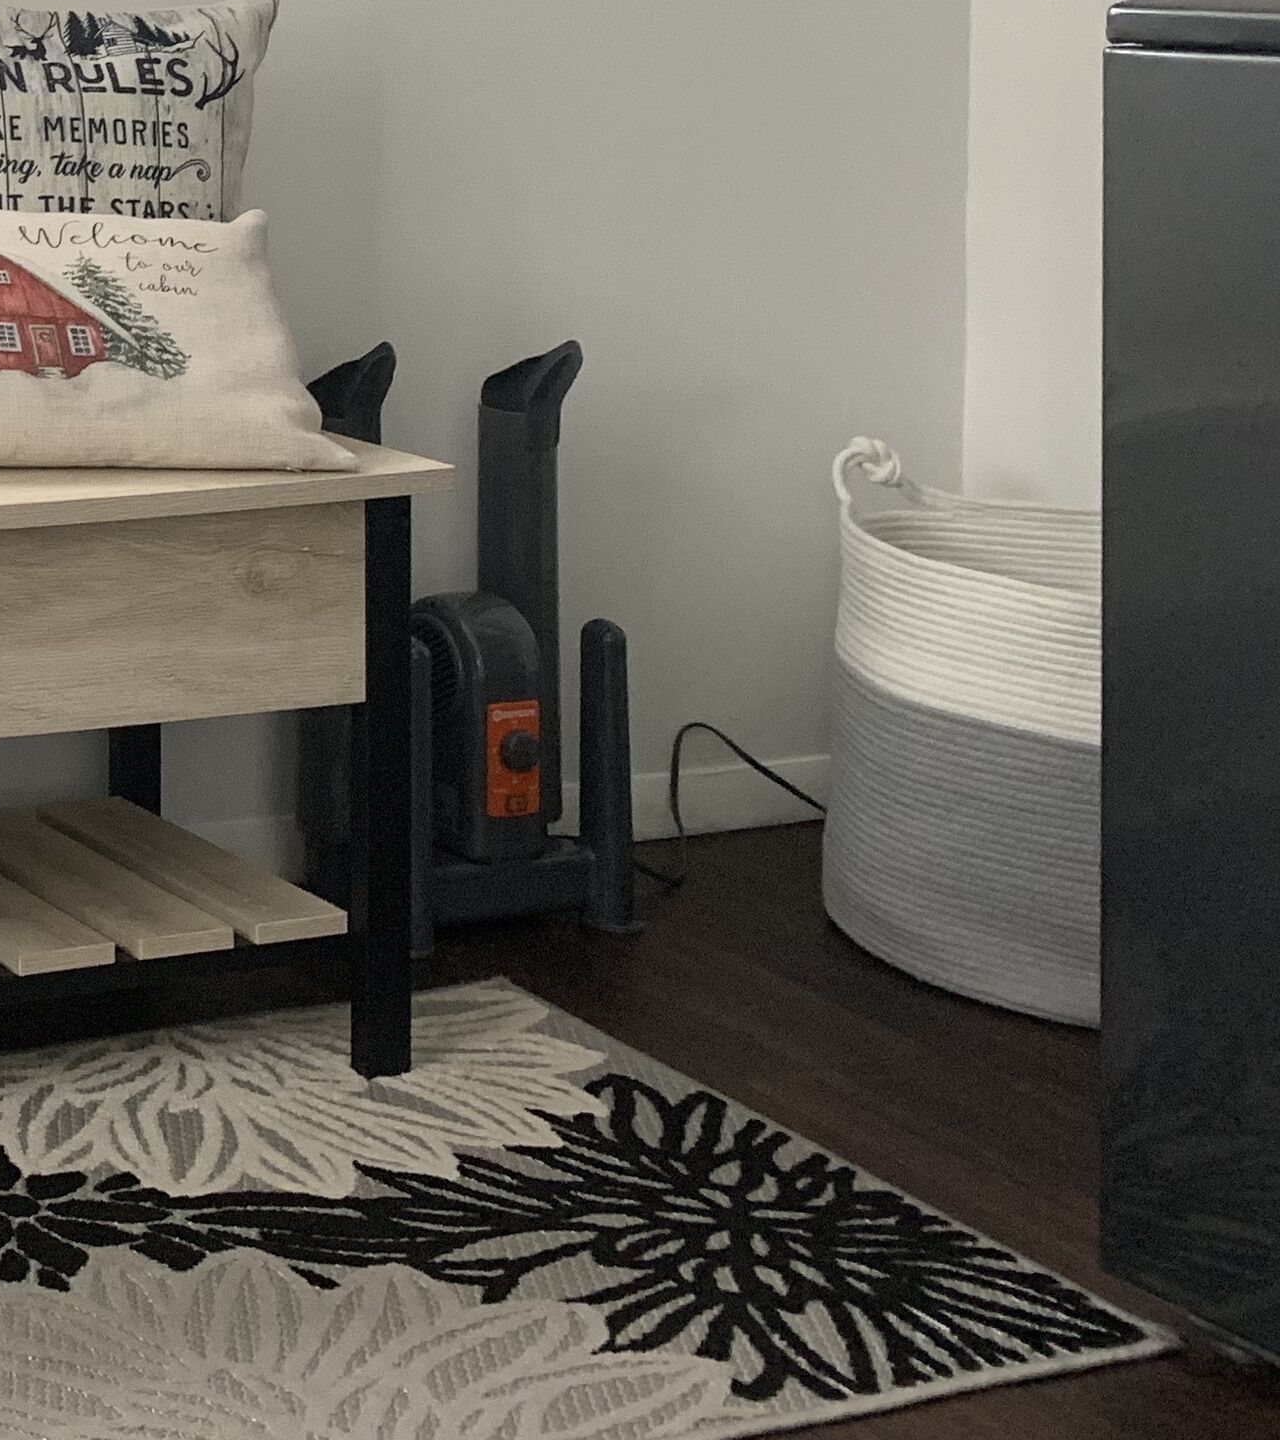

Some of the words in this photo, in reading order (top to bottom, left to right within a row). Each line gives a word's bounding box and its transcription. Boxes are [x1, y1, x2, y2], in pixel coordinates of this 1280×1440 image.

[43, 58, 194, 98] RULES
[44, 115, 190, 149] MEMORIES
[50, 150, 104, 183] take
[108, 161, 126, 178] a
[130, 161, 175, 189] nap
[18, 220, 219, 253] Welcome
[117, 252, 154, 272] to
[162, 260, 203, 277] our
[138, 274, 198, 296] cabin
